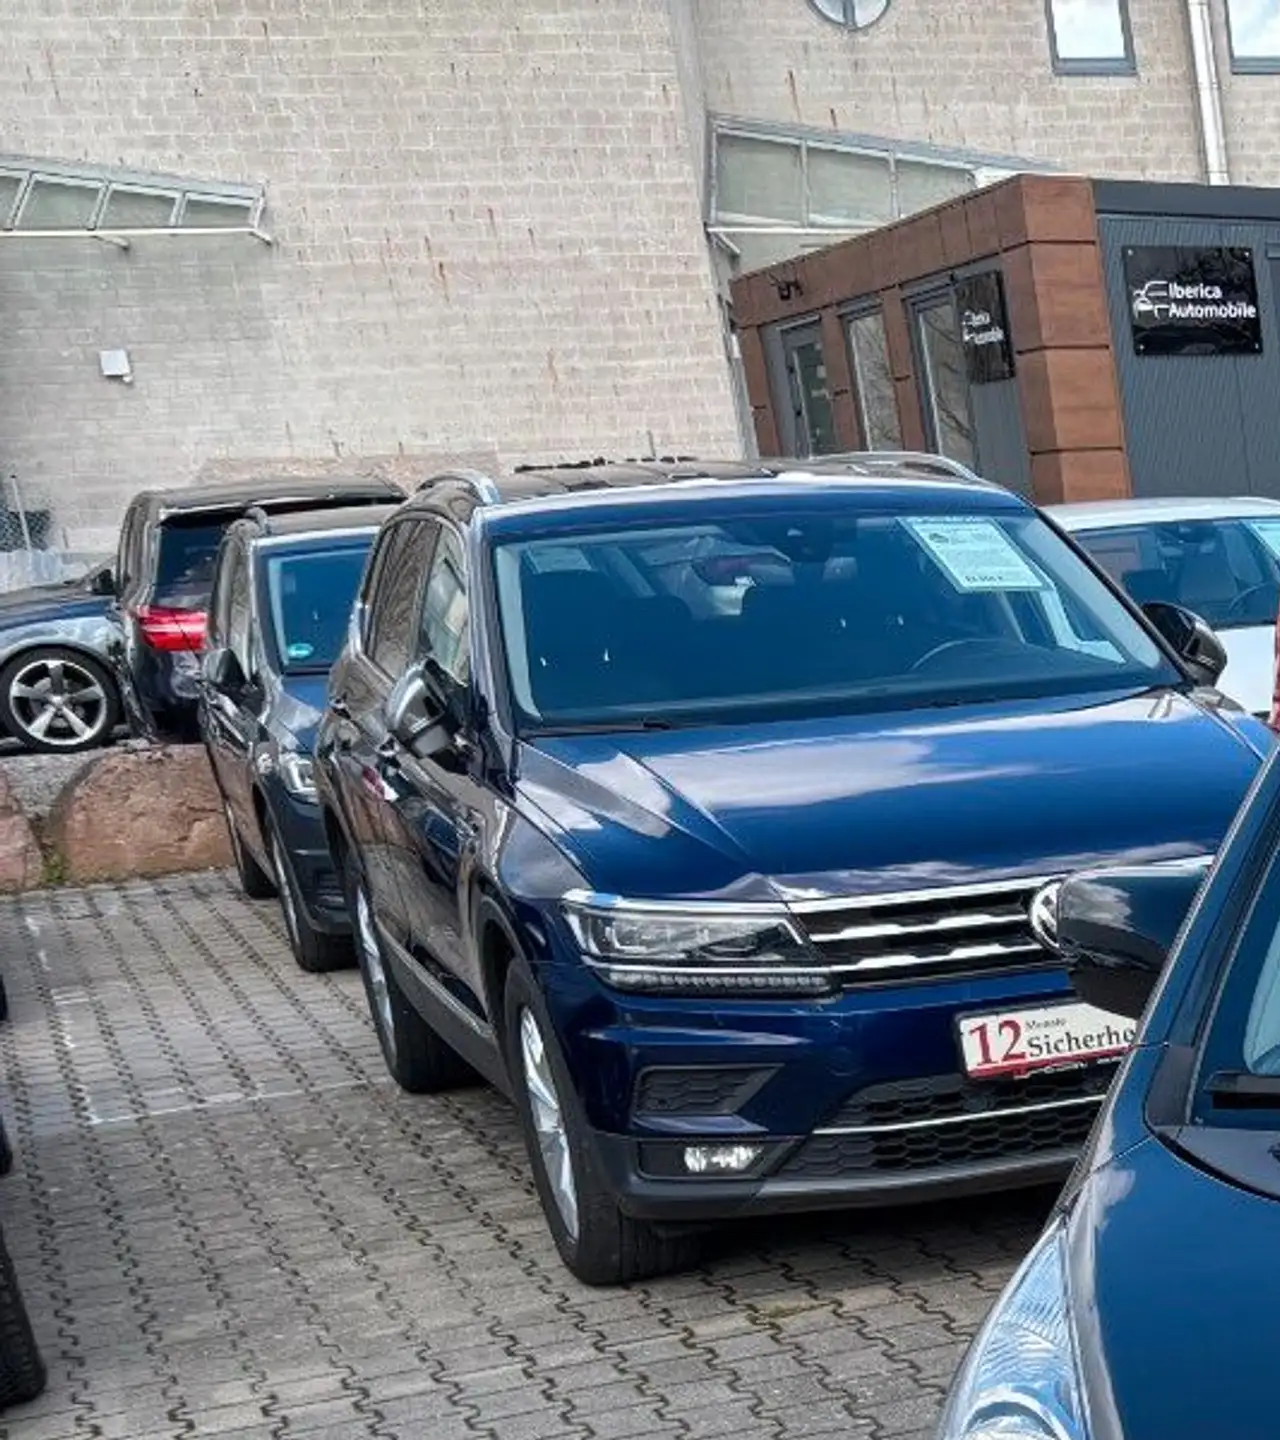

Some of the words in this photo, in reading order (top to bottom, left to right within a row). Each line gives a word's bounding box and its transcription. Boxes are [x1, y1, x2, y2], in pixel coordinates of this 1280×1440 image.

[1168, 282, 1222, 299] Iberica
[1168, 301, 1257, 318] Automobile
[969, 1019, 1026, 1065] 12
